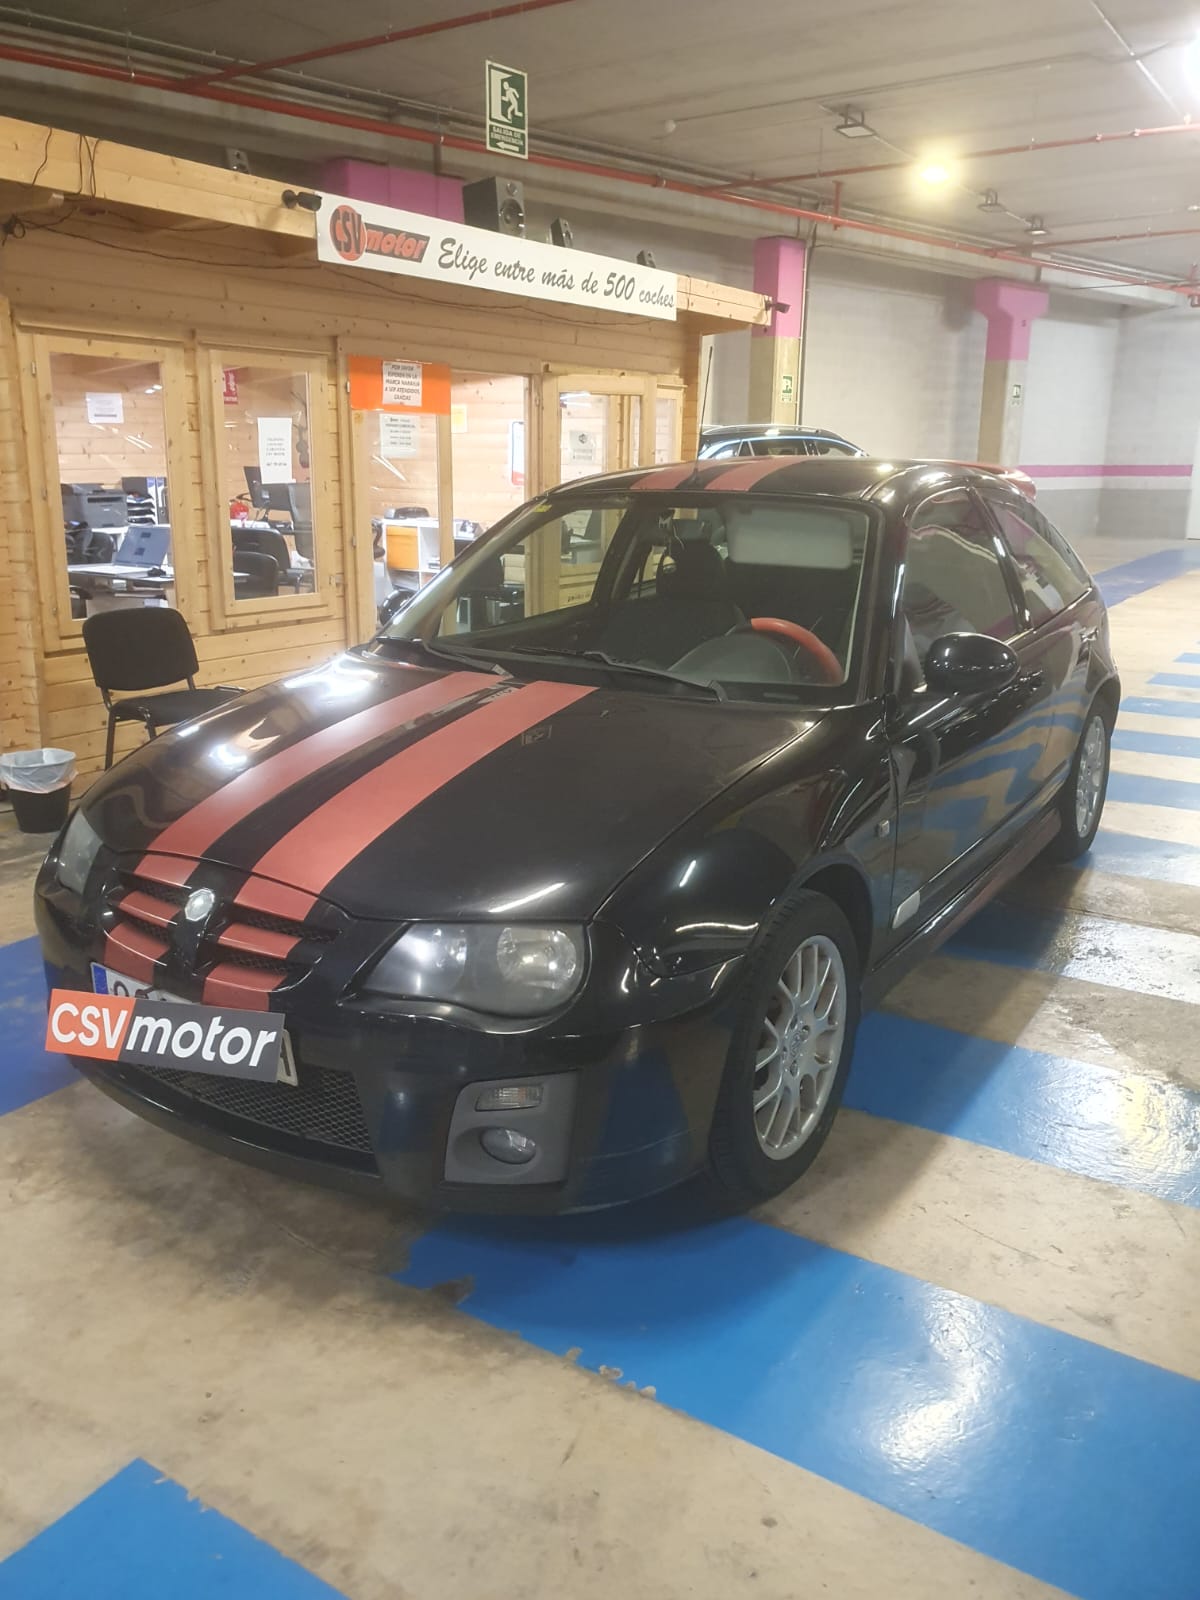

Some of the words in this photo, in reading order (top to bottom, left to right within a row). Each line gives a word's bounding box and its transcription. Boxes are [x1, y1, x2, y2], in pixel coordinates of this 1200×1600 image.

[493, 126, 512, 136] SALIDA
[438, 237, 488, 280] Elige
[494, 260, 535, 283] entre
[541, 269, 575, 290] más
[581, 271, 599, 294] de
[603, 272, 635, 300] 500
[639, 285, 674, 308] coches
[51, 1002, 277, 1067] CSVmotor
